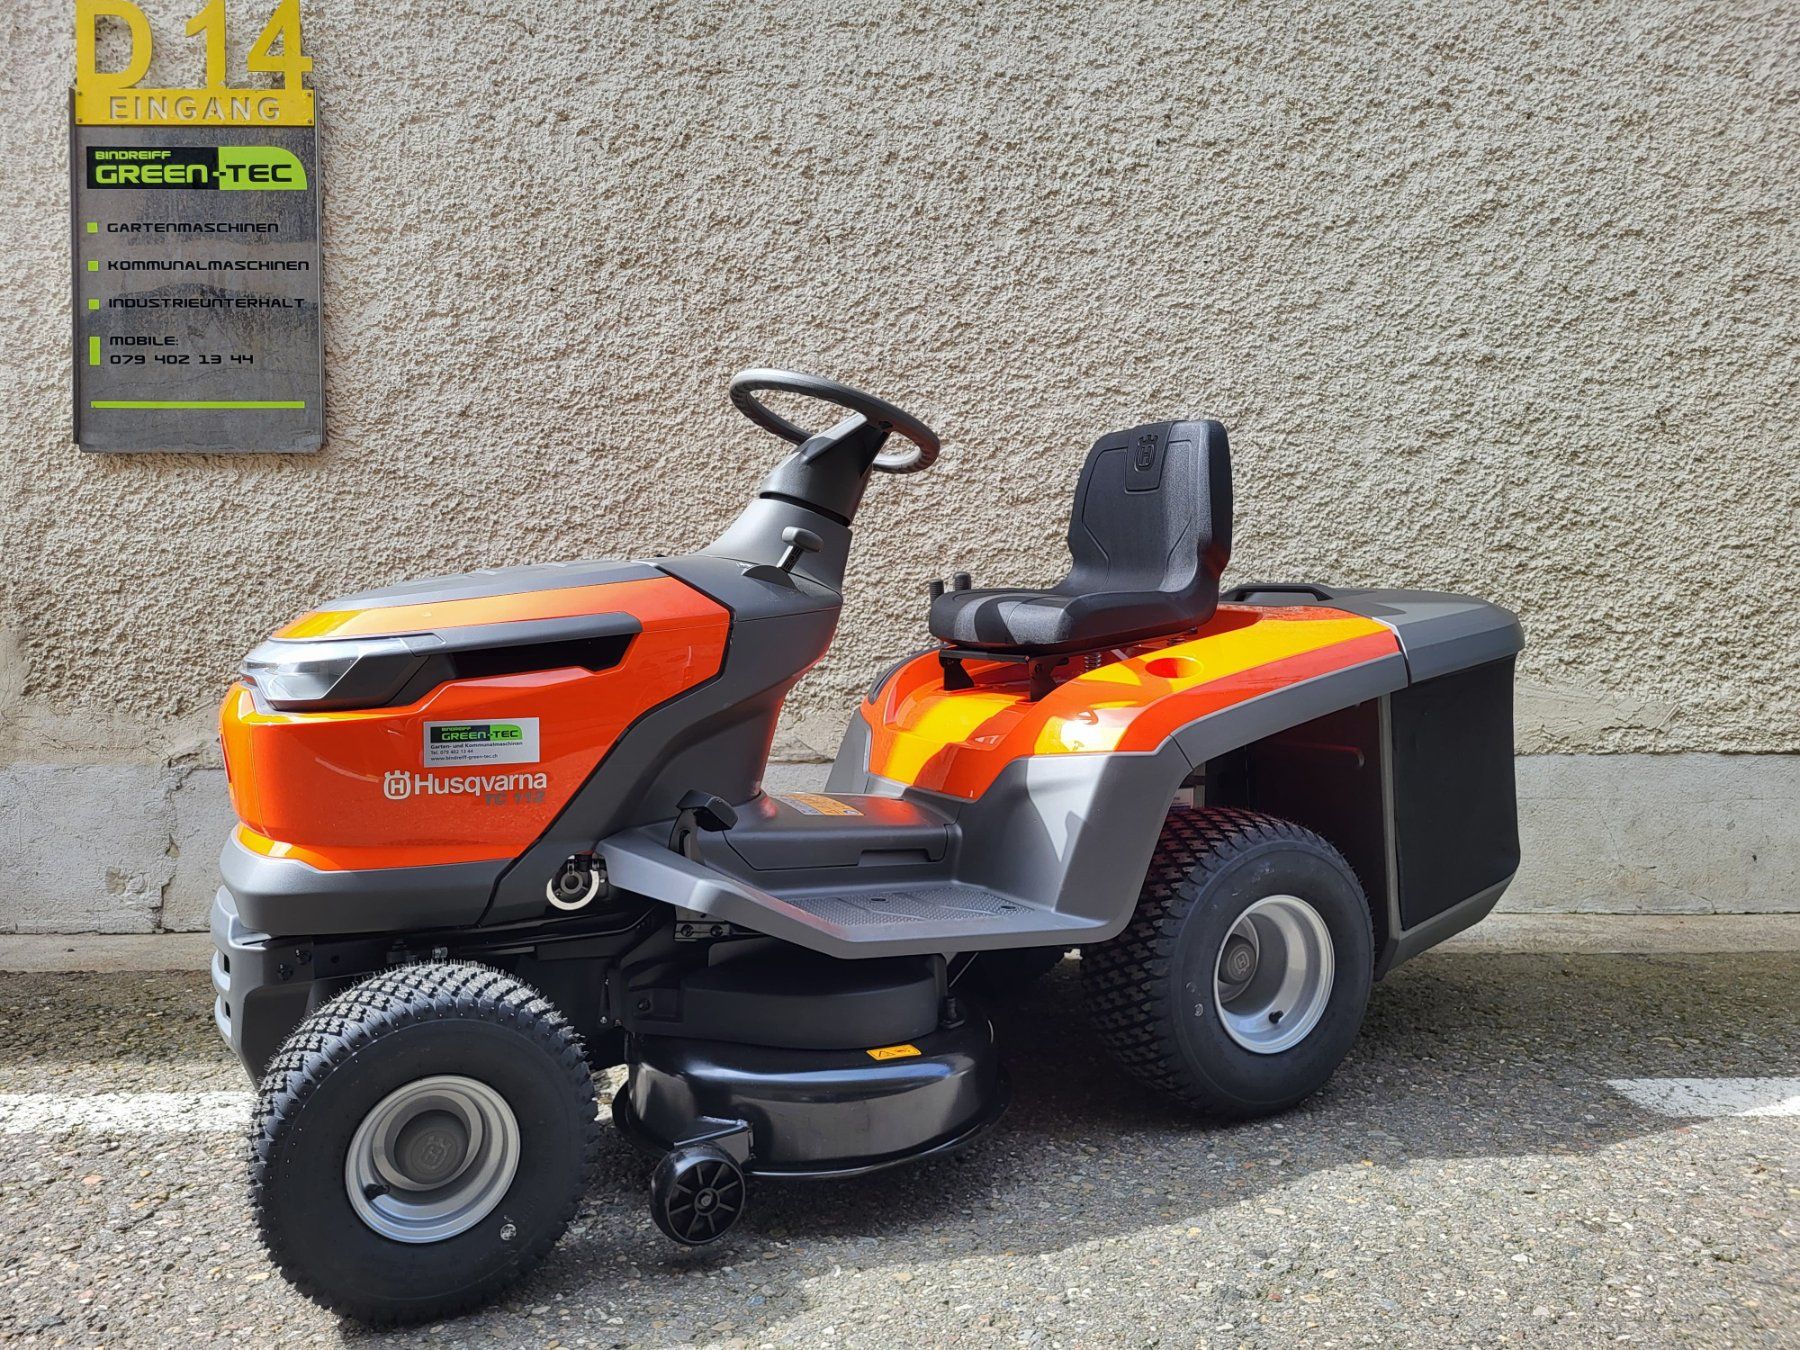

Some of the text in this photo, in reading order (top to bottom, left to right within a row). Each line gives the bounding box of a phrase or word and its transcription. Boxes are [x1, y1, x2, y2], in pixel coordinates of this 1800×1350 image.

[109, 95, 281, 121] EINGANG
[95, 150, 172, 160] BINDREIFF
[95, 164, 292, 184] GREEN-TEC
[107, 222, 279, 233] GARTENMASCHINEN
[107, 260, 310, 271] KOMMUNALMASCHINEN
[108, 298, 305, 309] INDUSTRIEUNTERHALT
[109, 336, 179, 346] MOBILE:
[110, 354, 254, 365] 079 402 13 44
[441, 730, 519, 741] GREEN-TEC
[414, 772, 548, 796] Husqvarna
